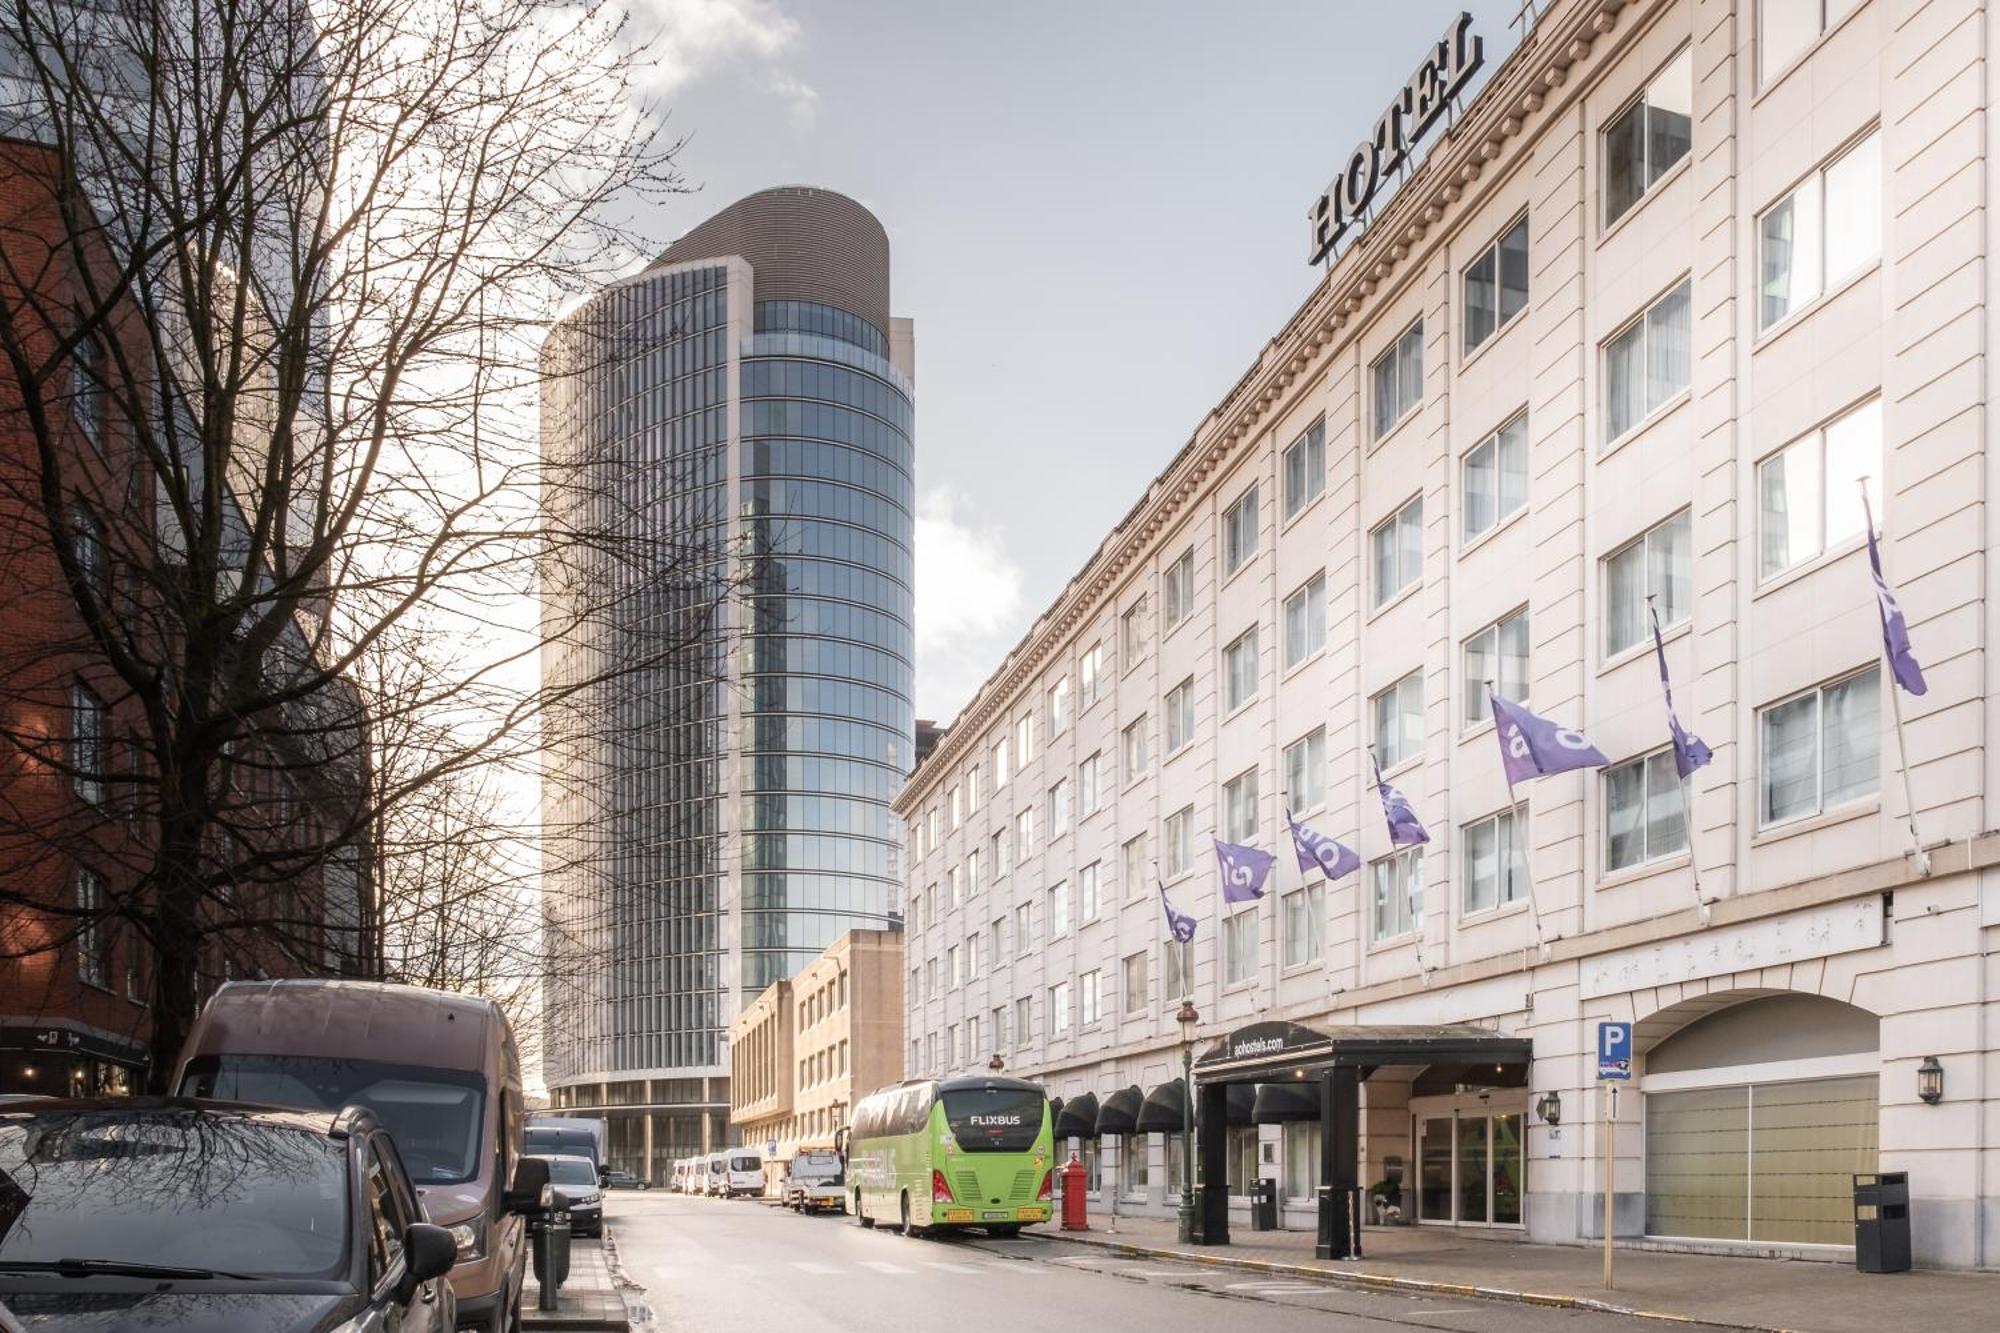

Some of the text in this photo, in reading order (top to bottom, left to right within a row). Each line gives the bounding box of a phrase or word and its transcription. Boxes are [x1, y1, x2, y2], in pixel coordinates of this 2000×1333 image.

[1308, 11, 1485, 266] HOTEL
[1605, 1026, 1625, 1056] P
[970, 1115, 1021, 1126] FLIXBUS
